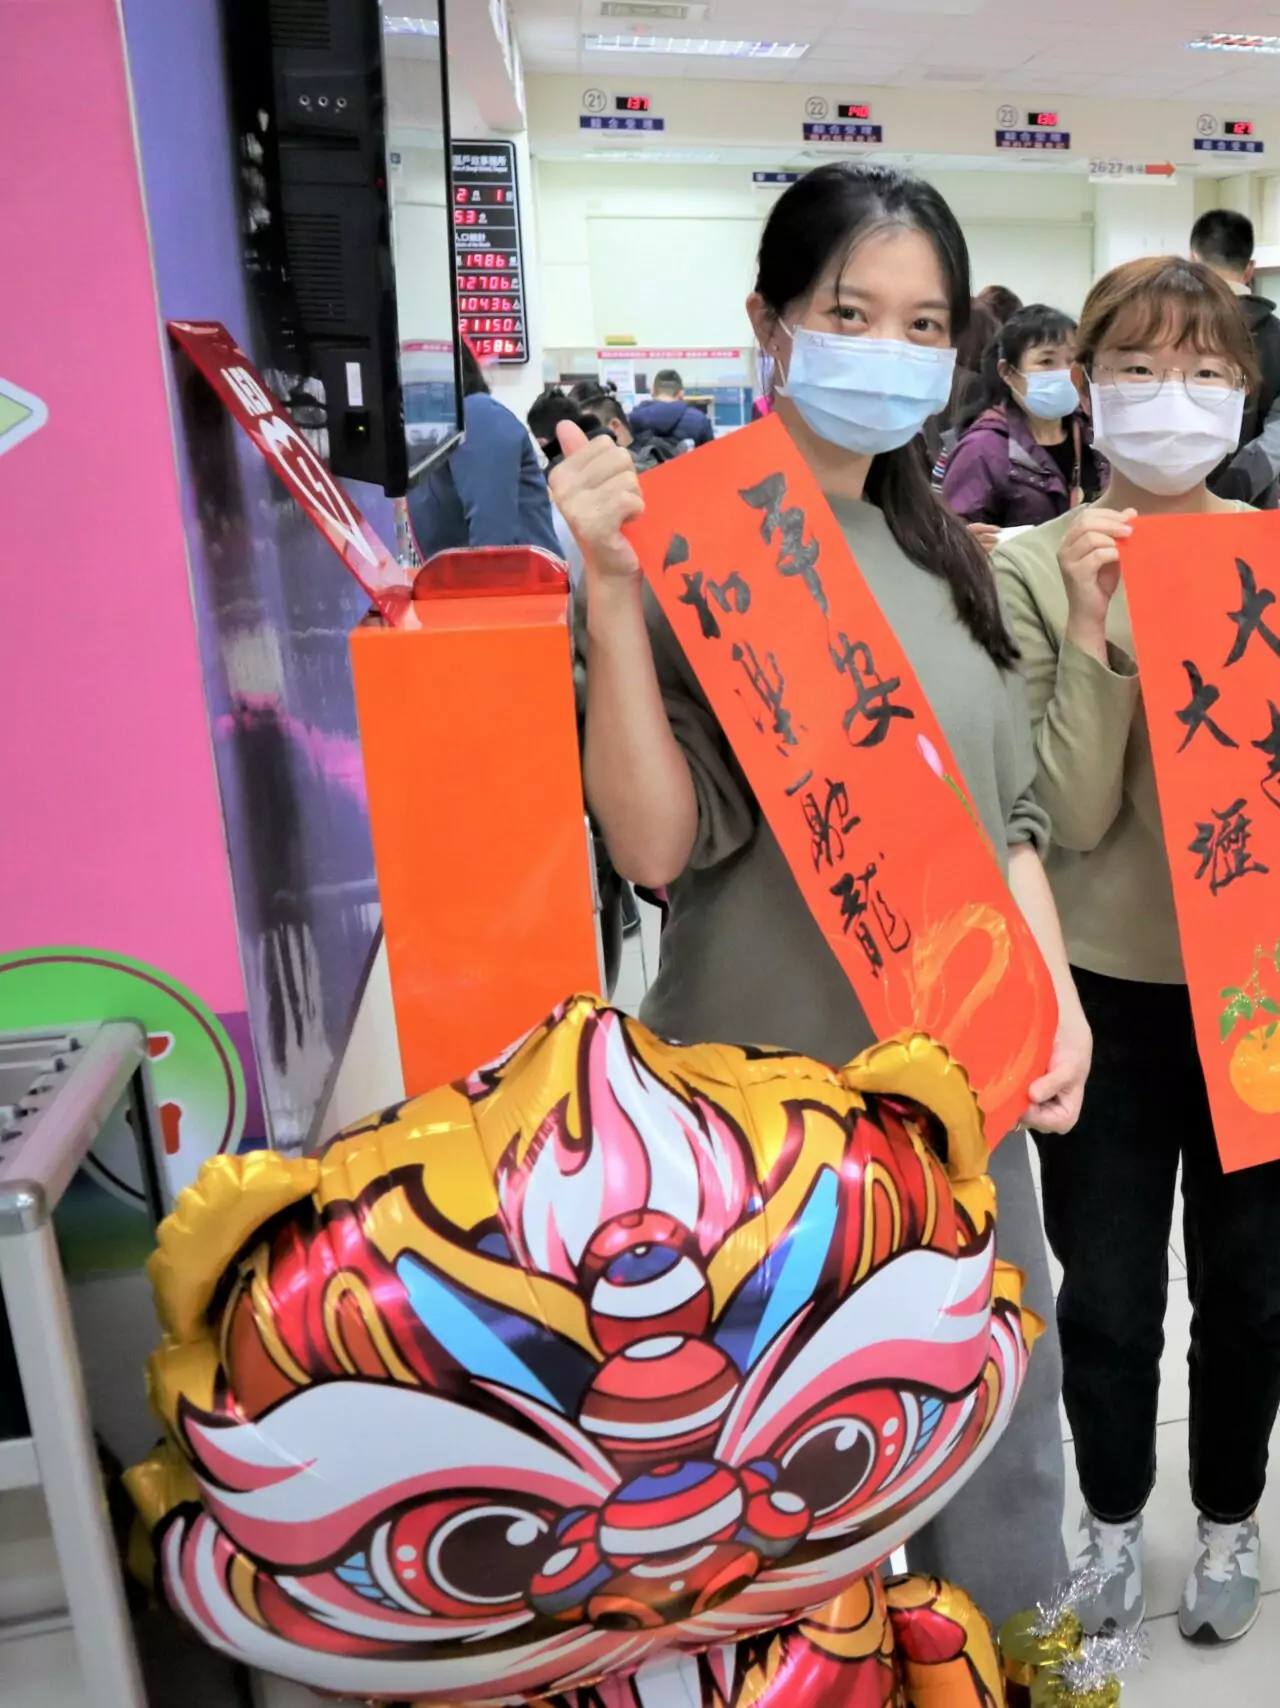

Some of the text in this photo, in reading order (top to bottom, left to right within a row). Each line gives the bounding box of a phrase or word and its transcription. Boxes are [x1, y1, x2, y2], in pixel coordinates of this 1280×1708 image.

[809, 101, 824, 116] 22
[1000, 108, 1015, 123] 23
[1200, 117, 1214, 132] 24
[219, 366, 274, 418] AED
[738, 470, 916, 749] 平安
